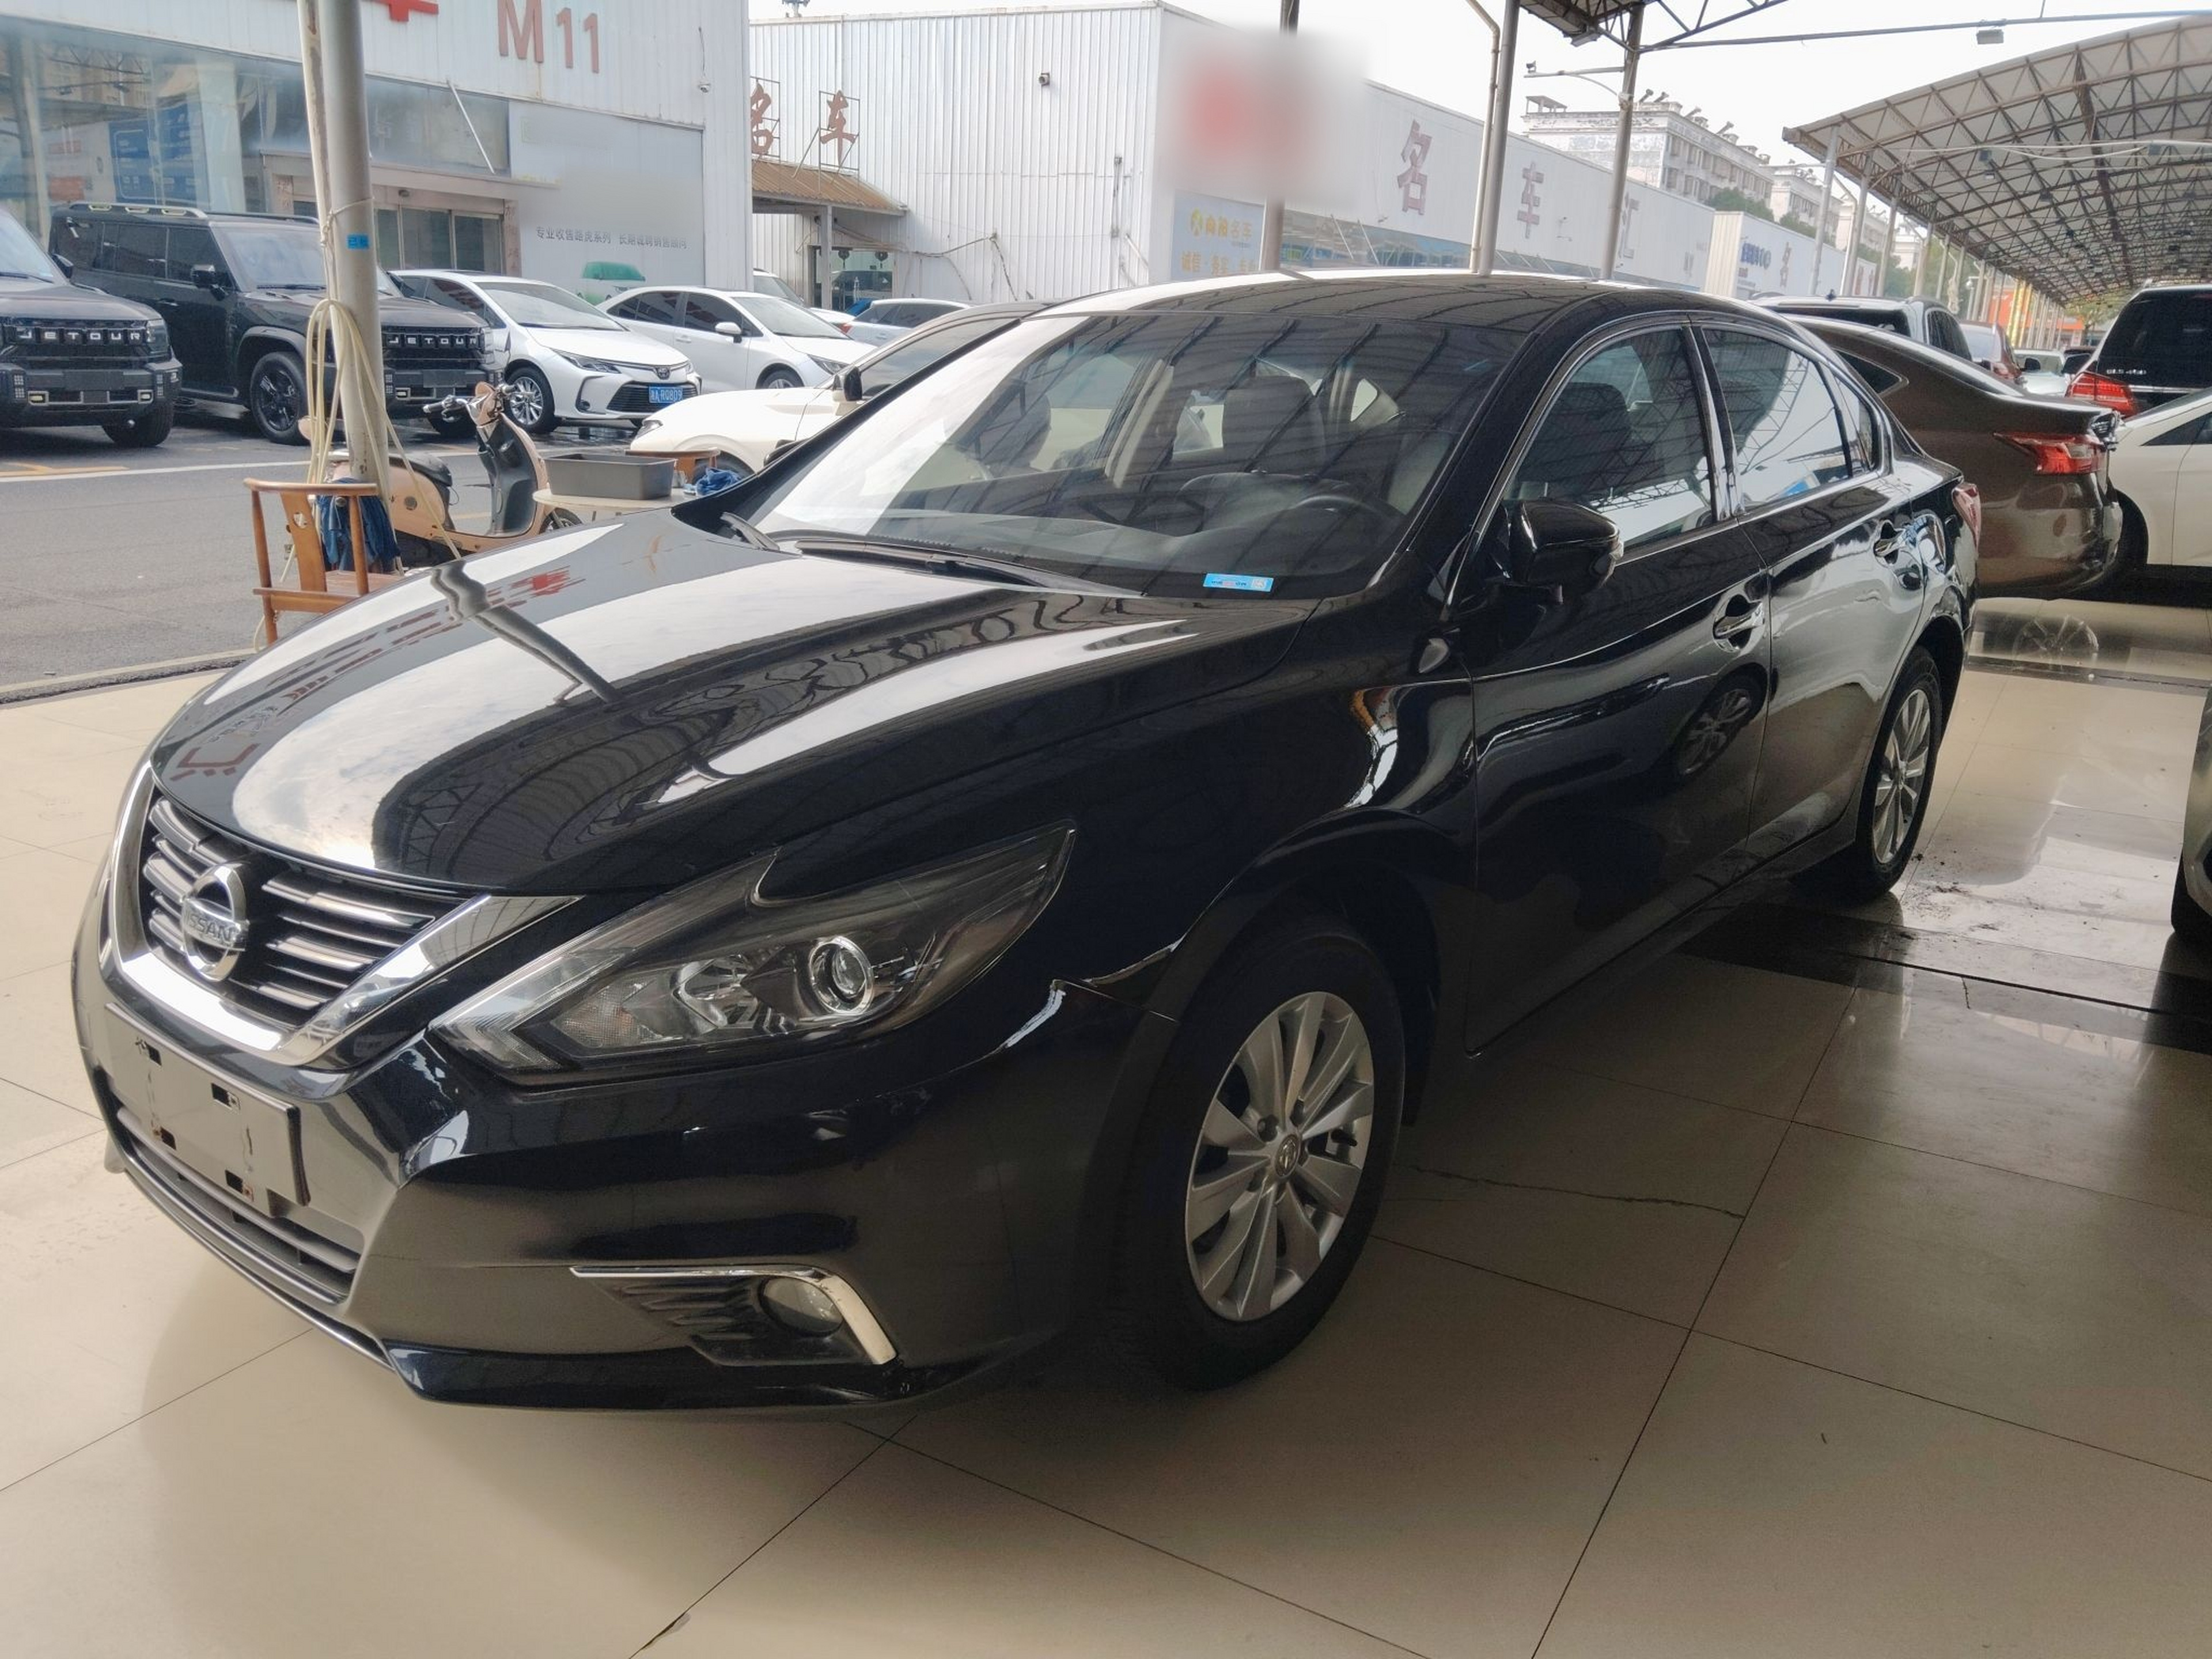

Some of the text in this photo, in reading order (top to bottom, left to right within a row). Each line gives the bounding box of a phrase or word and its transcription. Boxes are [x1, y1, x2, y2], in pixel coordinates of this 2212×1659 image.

[497, 0, 600, 74] M11
[18, 331, 141, 340] JETOUR
[389, 336, 477, 344] JETOUR
